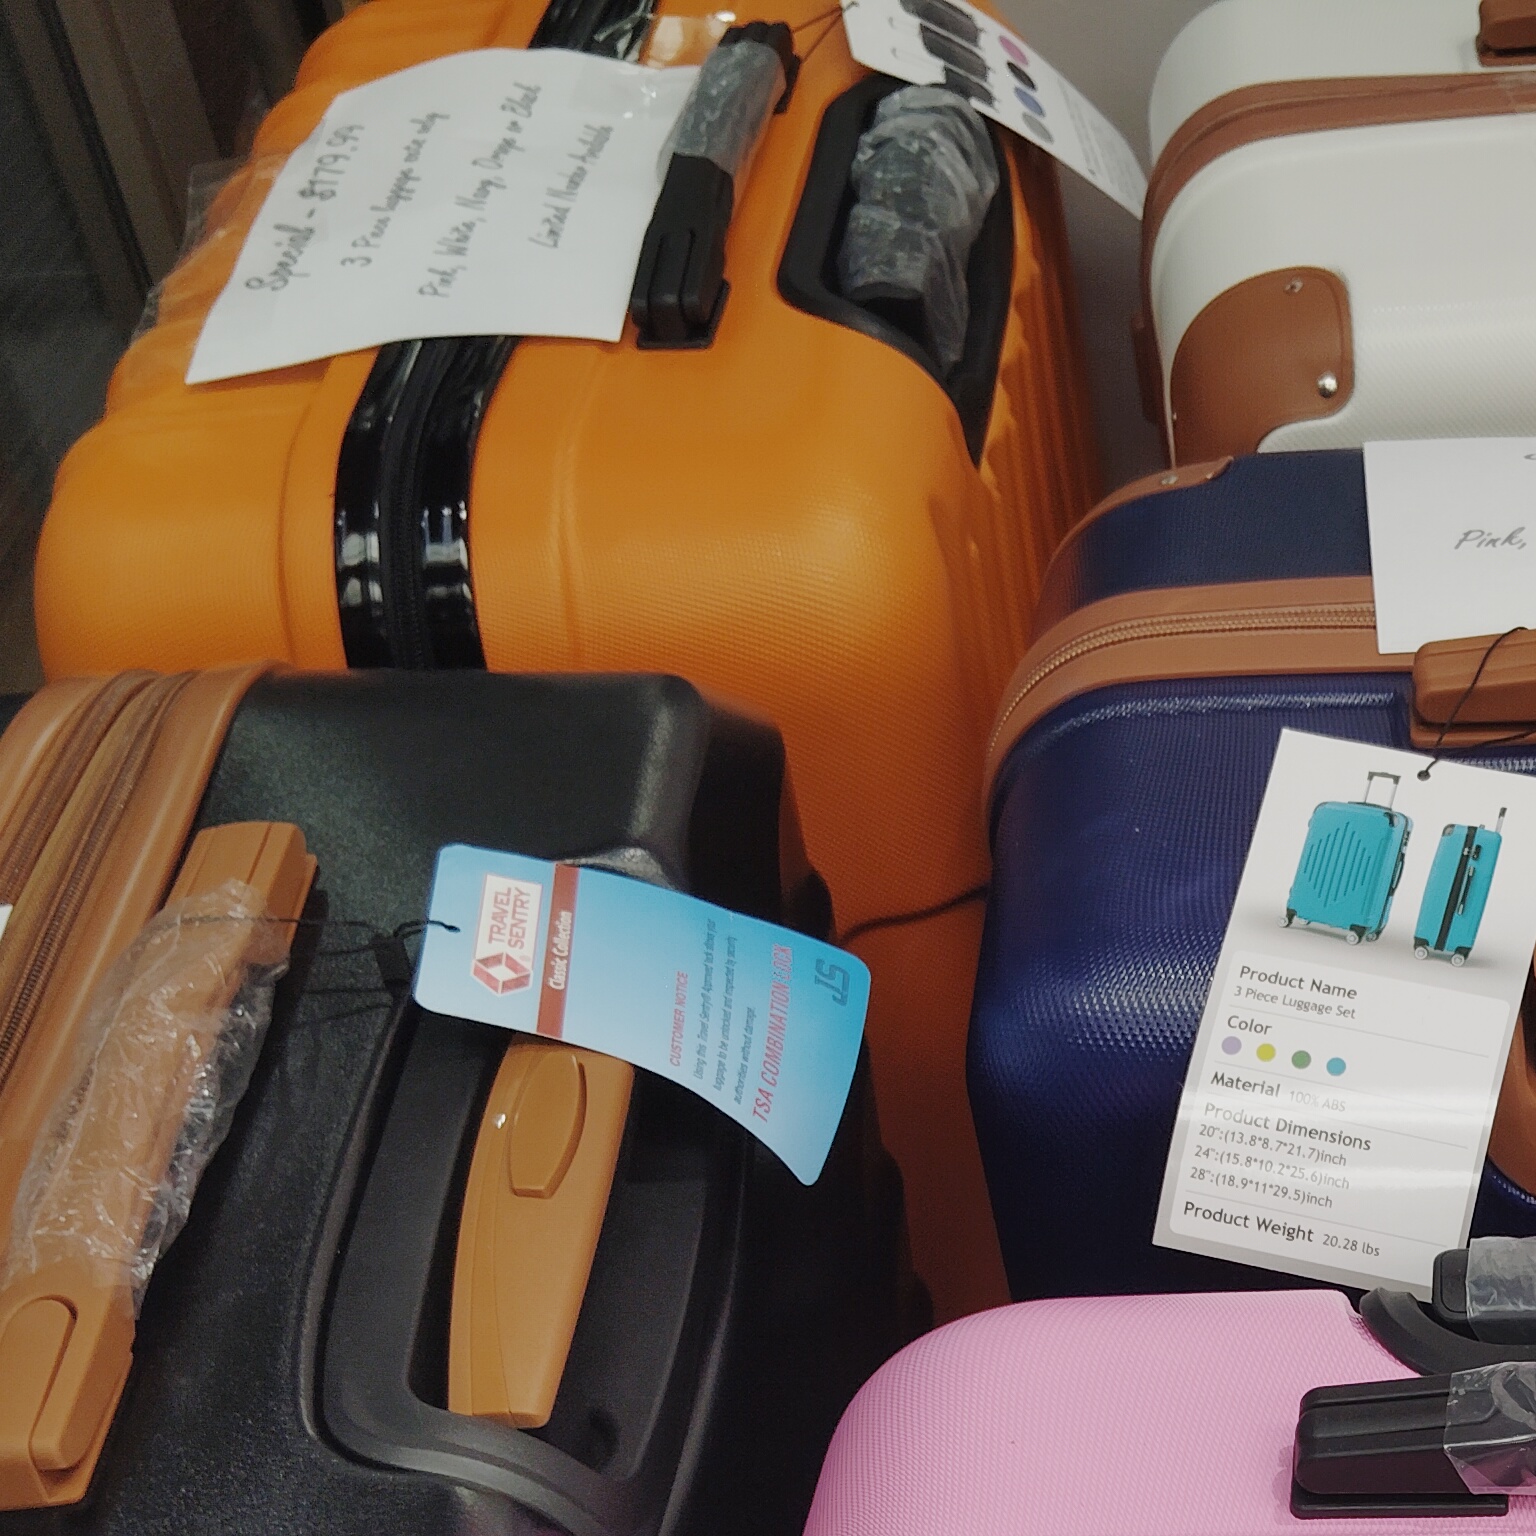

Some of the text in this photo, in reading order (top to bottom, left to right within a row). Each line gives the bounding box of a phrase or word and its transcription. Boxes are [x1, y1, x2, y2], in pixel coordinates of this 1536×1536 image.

[244, 222, 315, 291] Special
[340, 255, 373, 268] 3
[1453, 526, 1528, 551] Pink,
[488, 887, 512, 945] TRAVEL
[508, 886, 531, 950] SENTRY
[549, 909, 573, 990] Classic Collection
[1233, 985, 1356, 1019] 3 Piece Luggage Set
[1239, 965, 1358, 999] Product Name
[669, 970, 689, 1067] CUSTOMER NOTICE
[753, 943, 793, 1124] TSA COMBINATION LOCK
[1227, 1015, 1273, 1035] Color
[1210, 1070, 1347, 1112] Material 100% ABS
[1203, 1101, 1372, 1151] Product Dimensions
[1183, 1200, 1381, 1257] Product Weight 20.28 lbs
